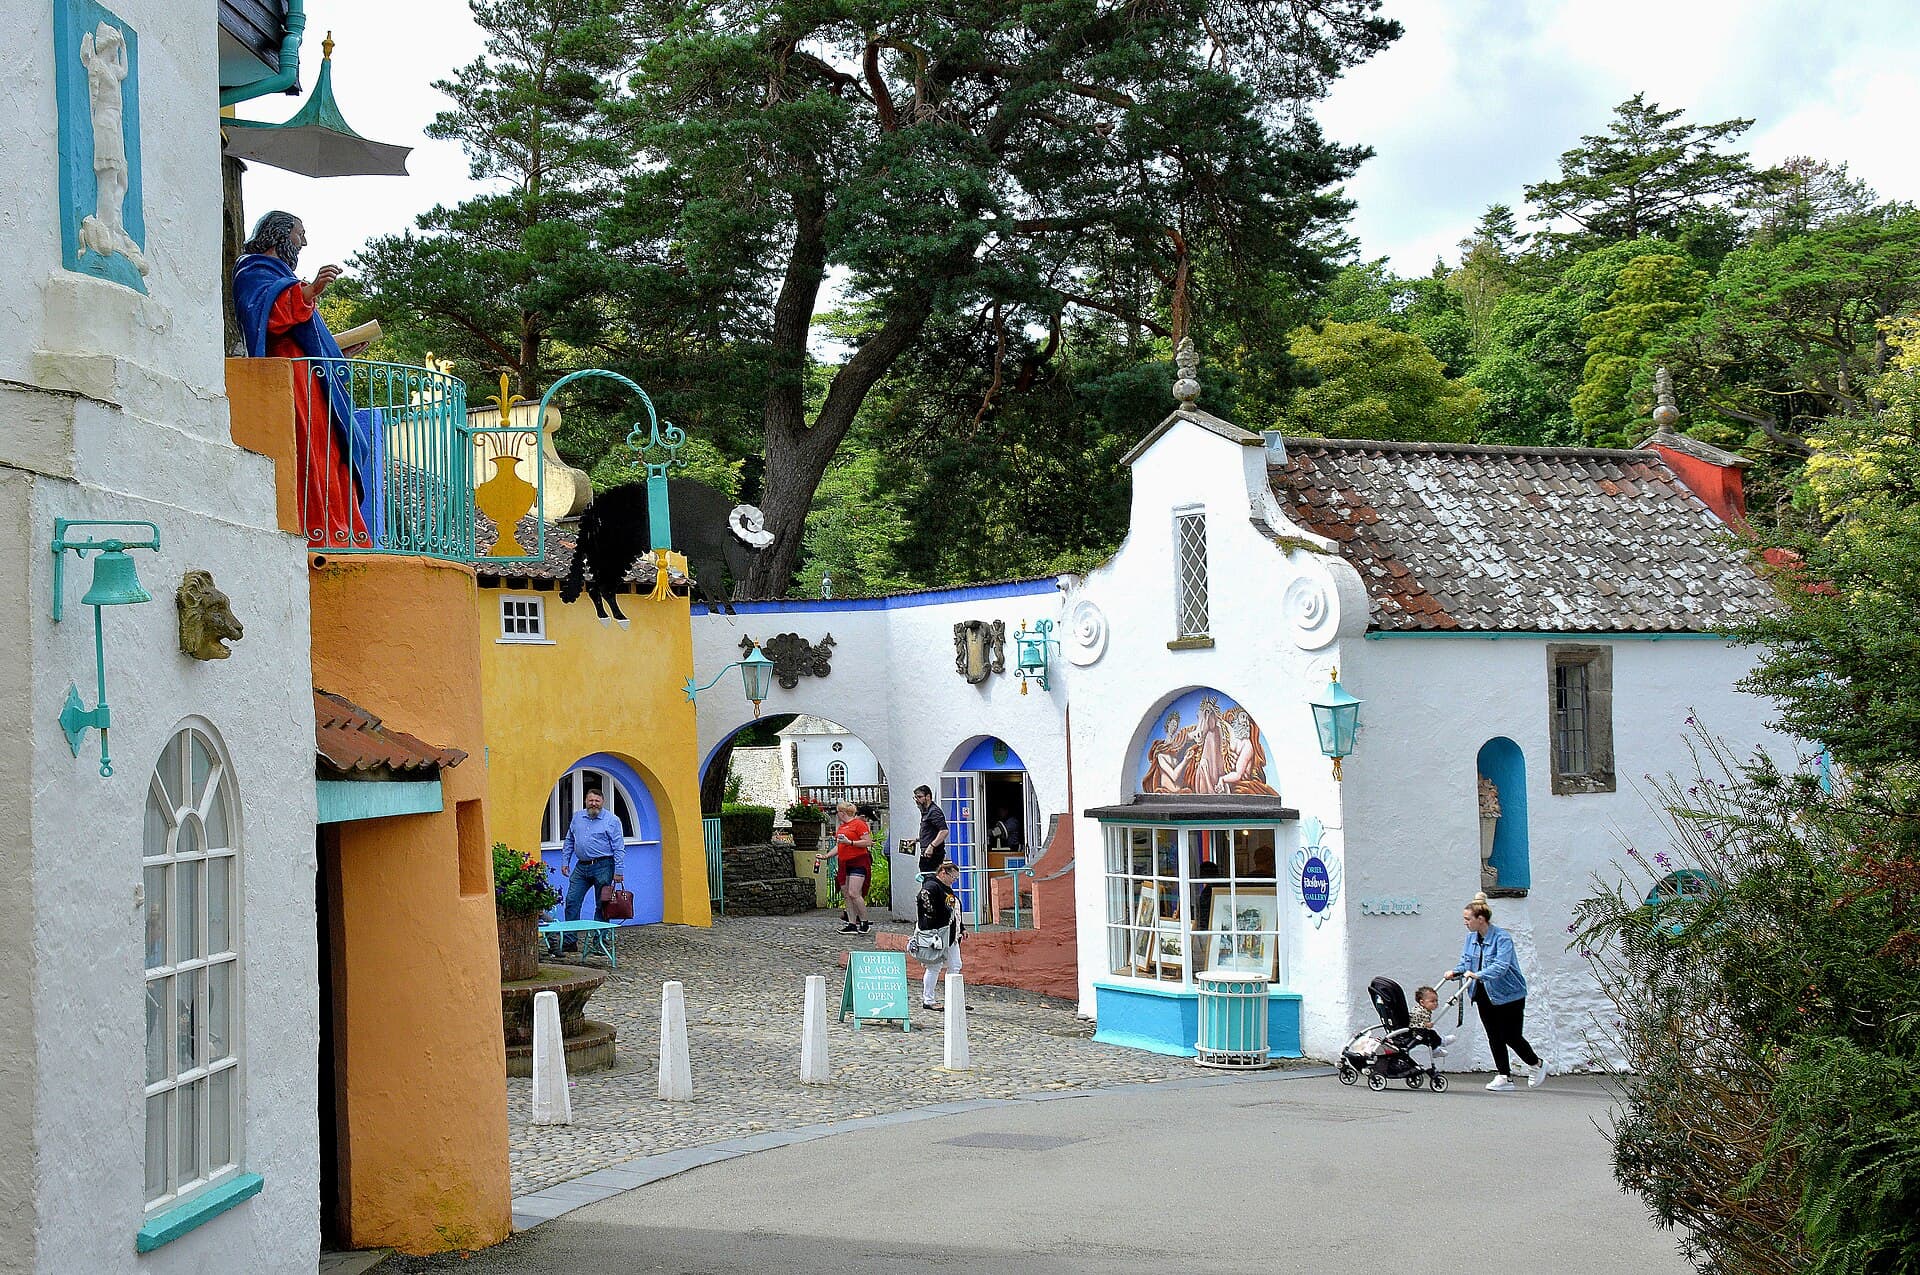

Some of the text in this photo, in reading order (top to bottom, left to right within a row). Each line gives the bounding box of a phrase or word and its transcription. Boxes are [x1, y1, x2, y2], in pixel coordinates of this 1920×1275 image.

[862, 955, 894, 964] ORIEL
[858, 965, 901, 974] AR AGOR
[856, 981, 902, 991] GALLERY
[867, 992, 894, 1001] OPEN
